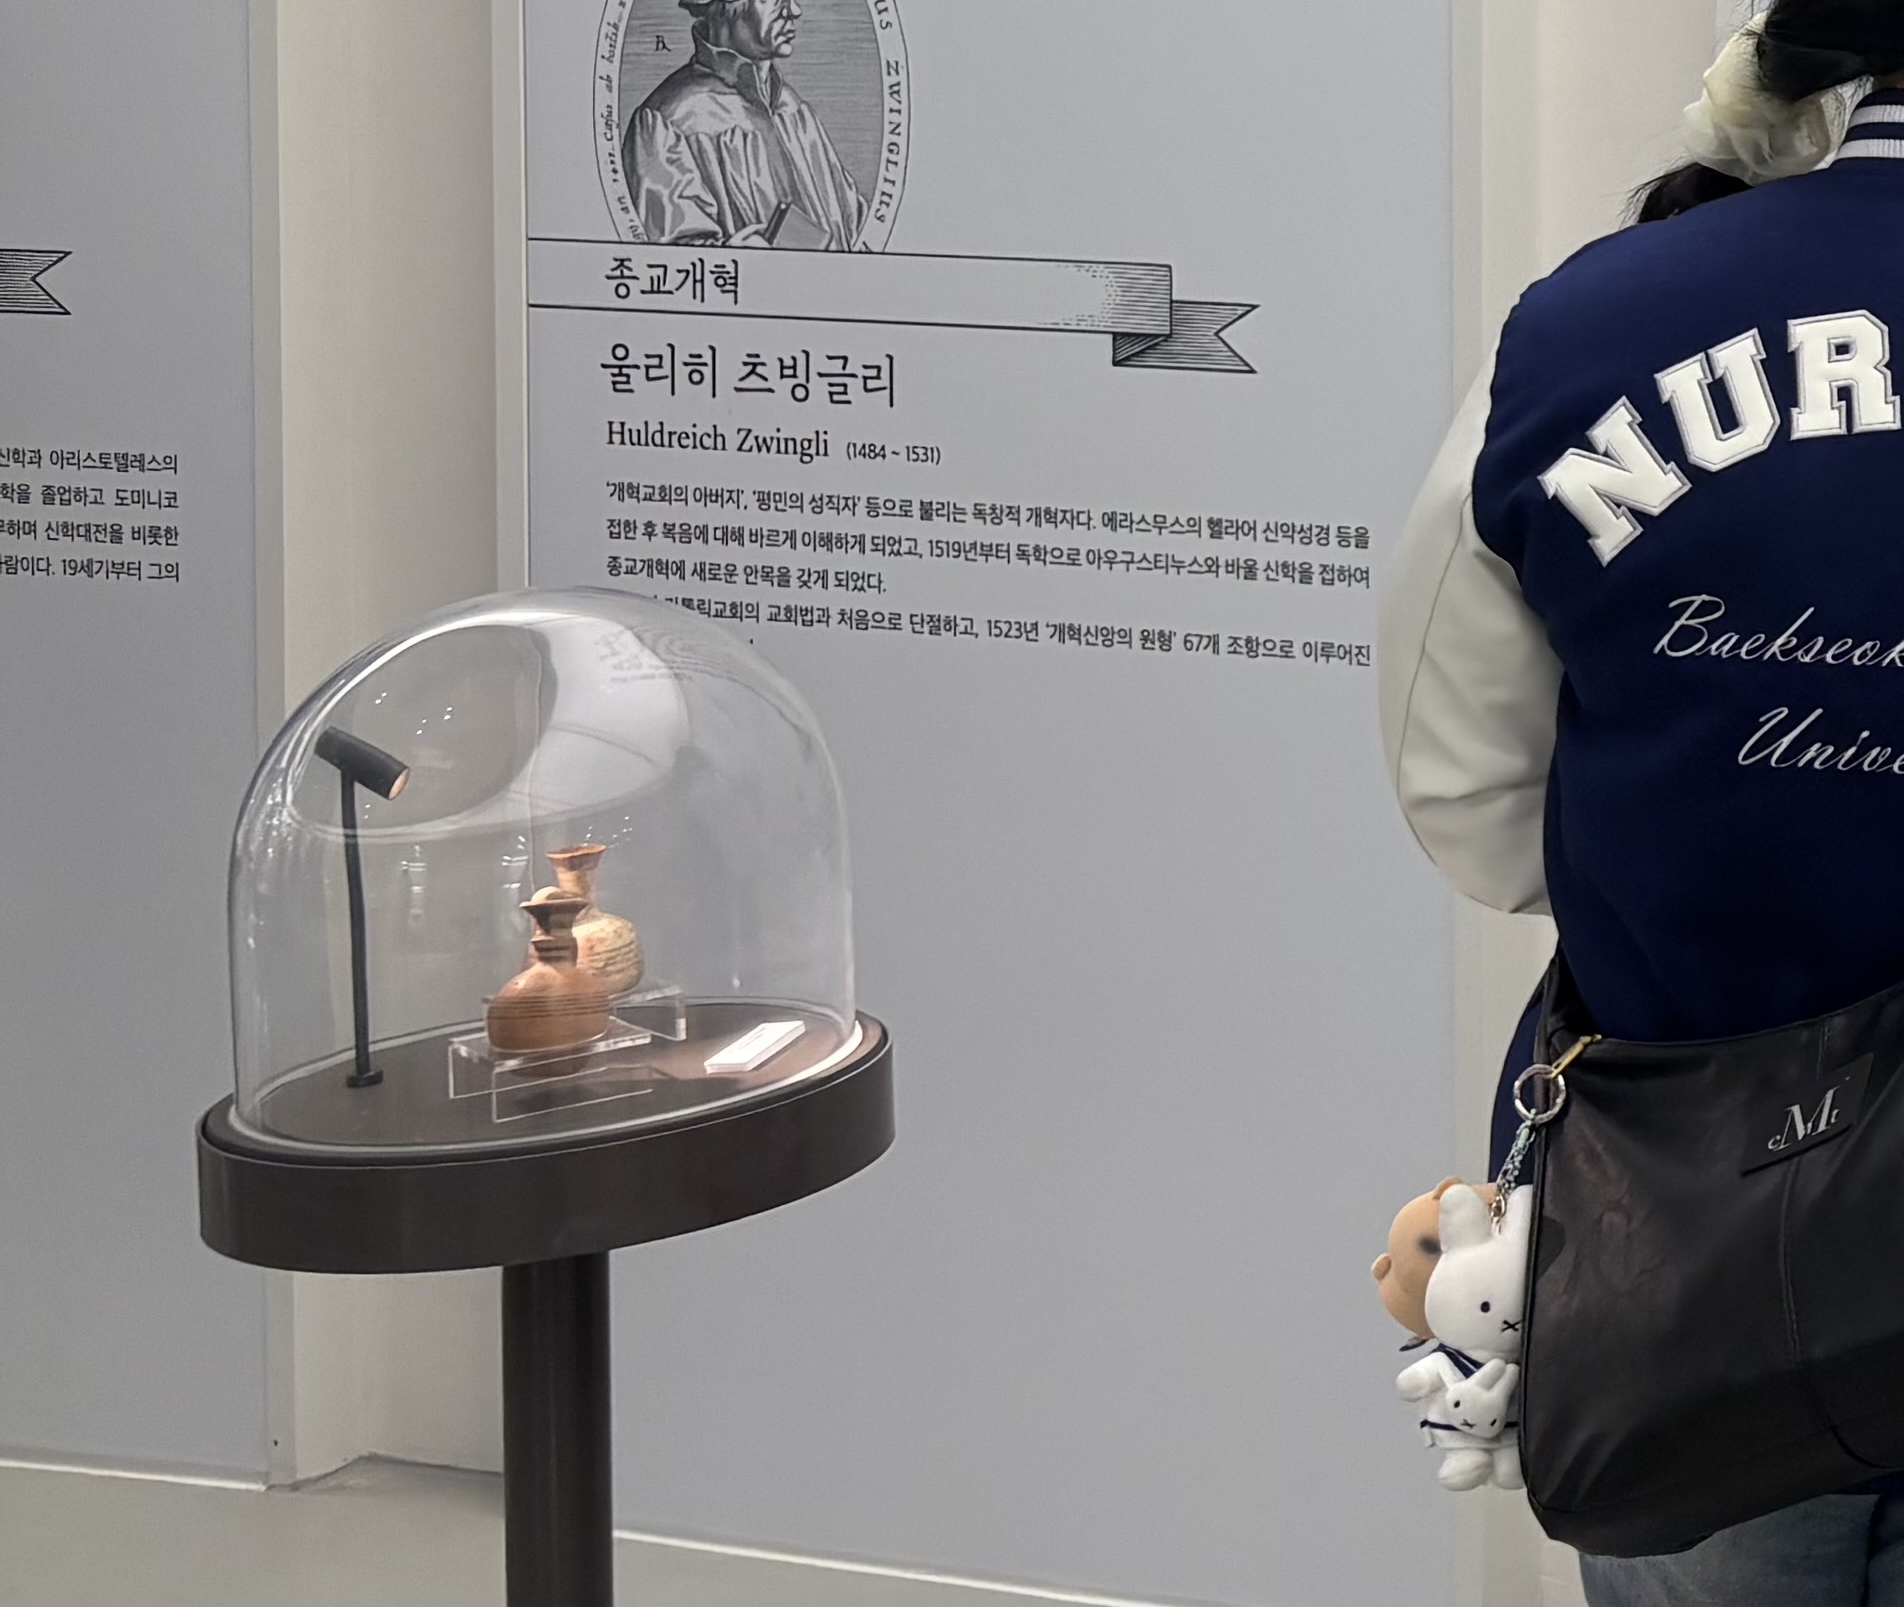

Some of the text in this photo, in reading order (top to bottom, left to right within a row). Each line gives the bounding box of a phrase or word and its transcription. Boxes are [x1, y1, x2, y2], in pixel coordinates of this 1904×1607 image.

[604, 256, 739, 306] 종교개혁
[599, 342, 895, 409] 울리히 츠빙글리
[606, 419, 728, 452] Huldreich
[736, 426, 830, 465] Zwingli
[49, 449, 178, 476] 아리스토텔레스의
[40, 484, 106, 508] 졸업하고
[113, 488, 180, 511] 도미니코
[44, 520, 180, 547] 신학대전을 비롯한
[60, 557, 180, 583] 19세기부터 그의
[606, 555, 686, 582] 종교개혁에
[690, 560, 739, 585] 새로운
[742, 564, 793, 589] 안목을
[796, 567, 829, 591] 갖게
[766, 603, 832, 629] 교회법과
[836, 607, 904, 632] 처음으로
[986, 619, 1039, 643] 1523년
[1183, 632, 1220, 656] 67개
[1226, 635, 1297, 660] 조항으로
[1301, 640, 1371, 667] 이루어진
